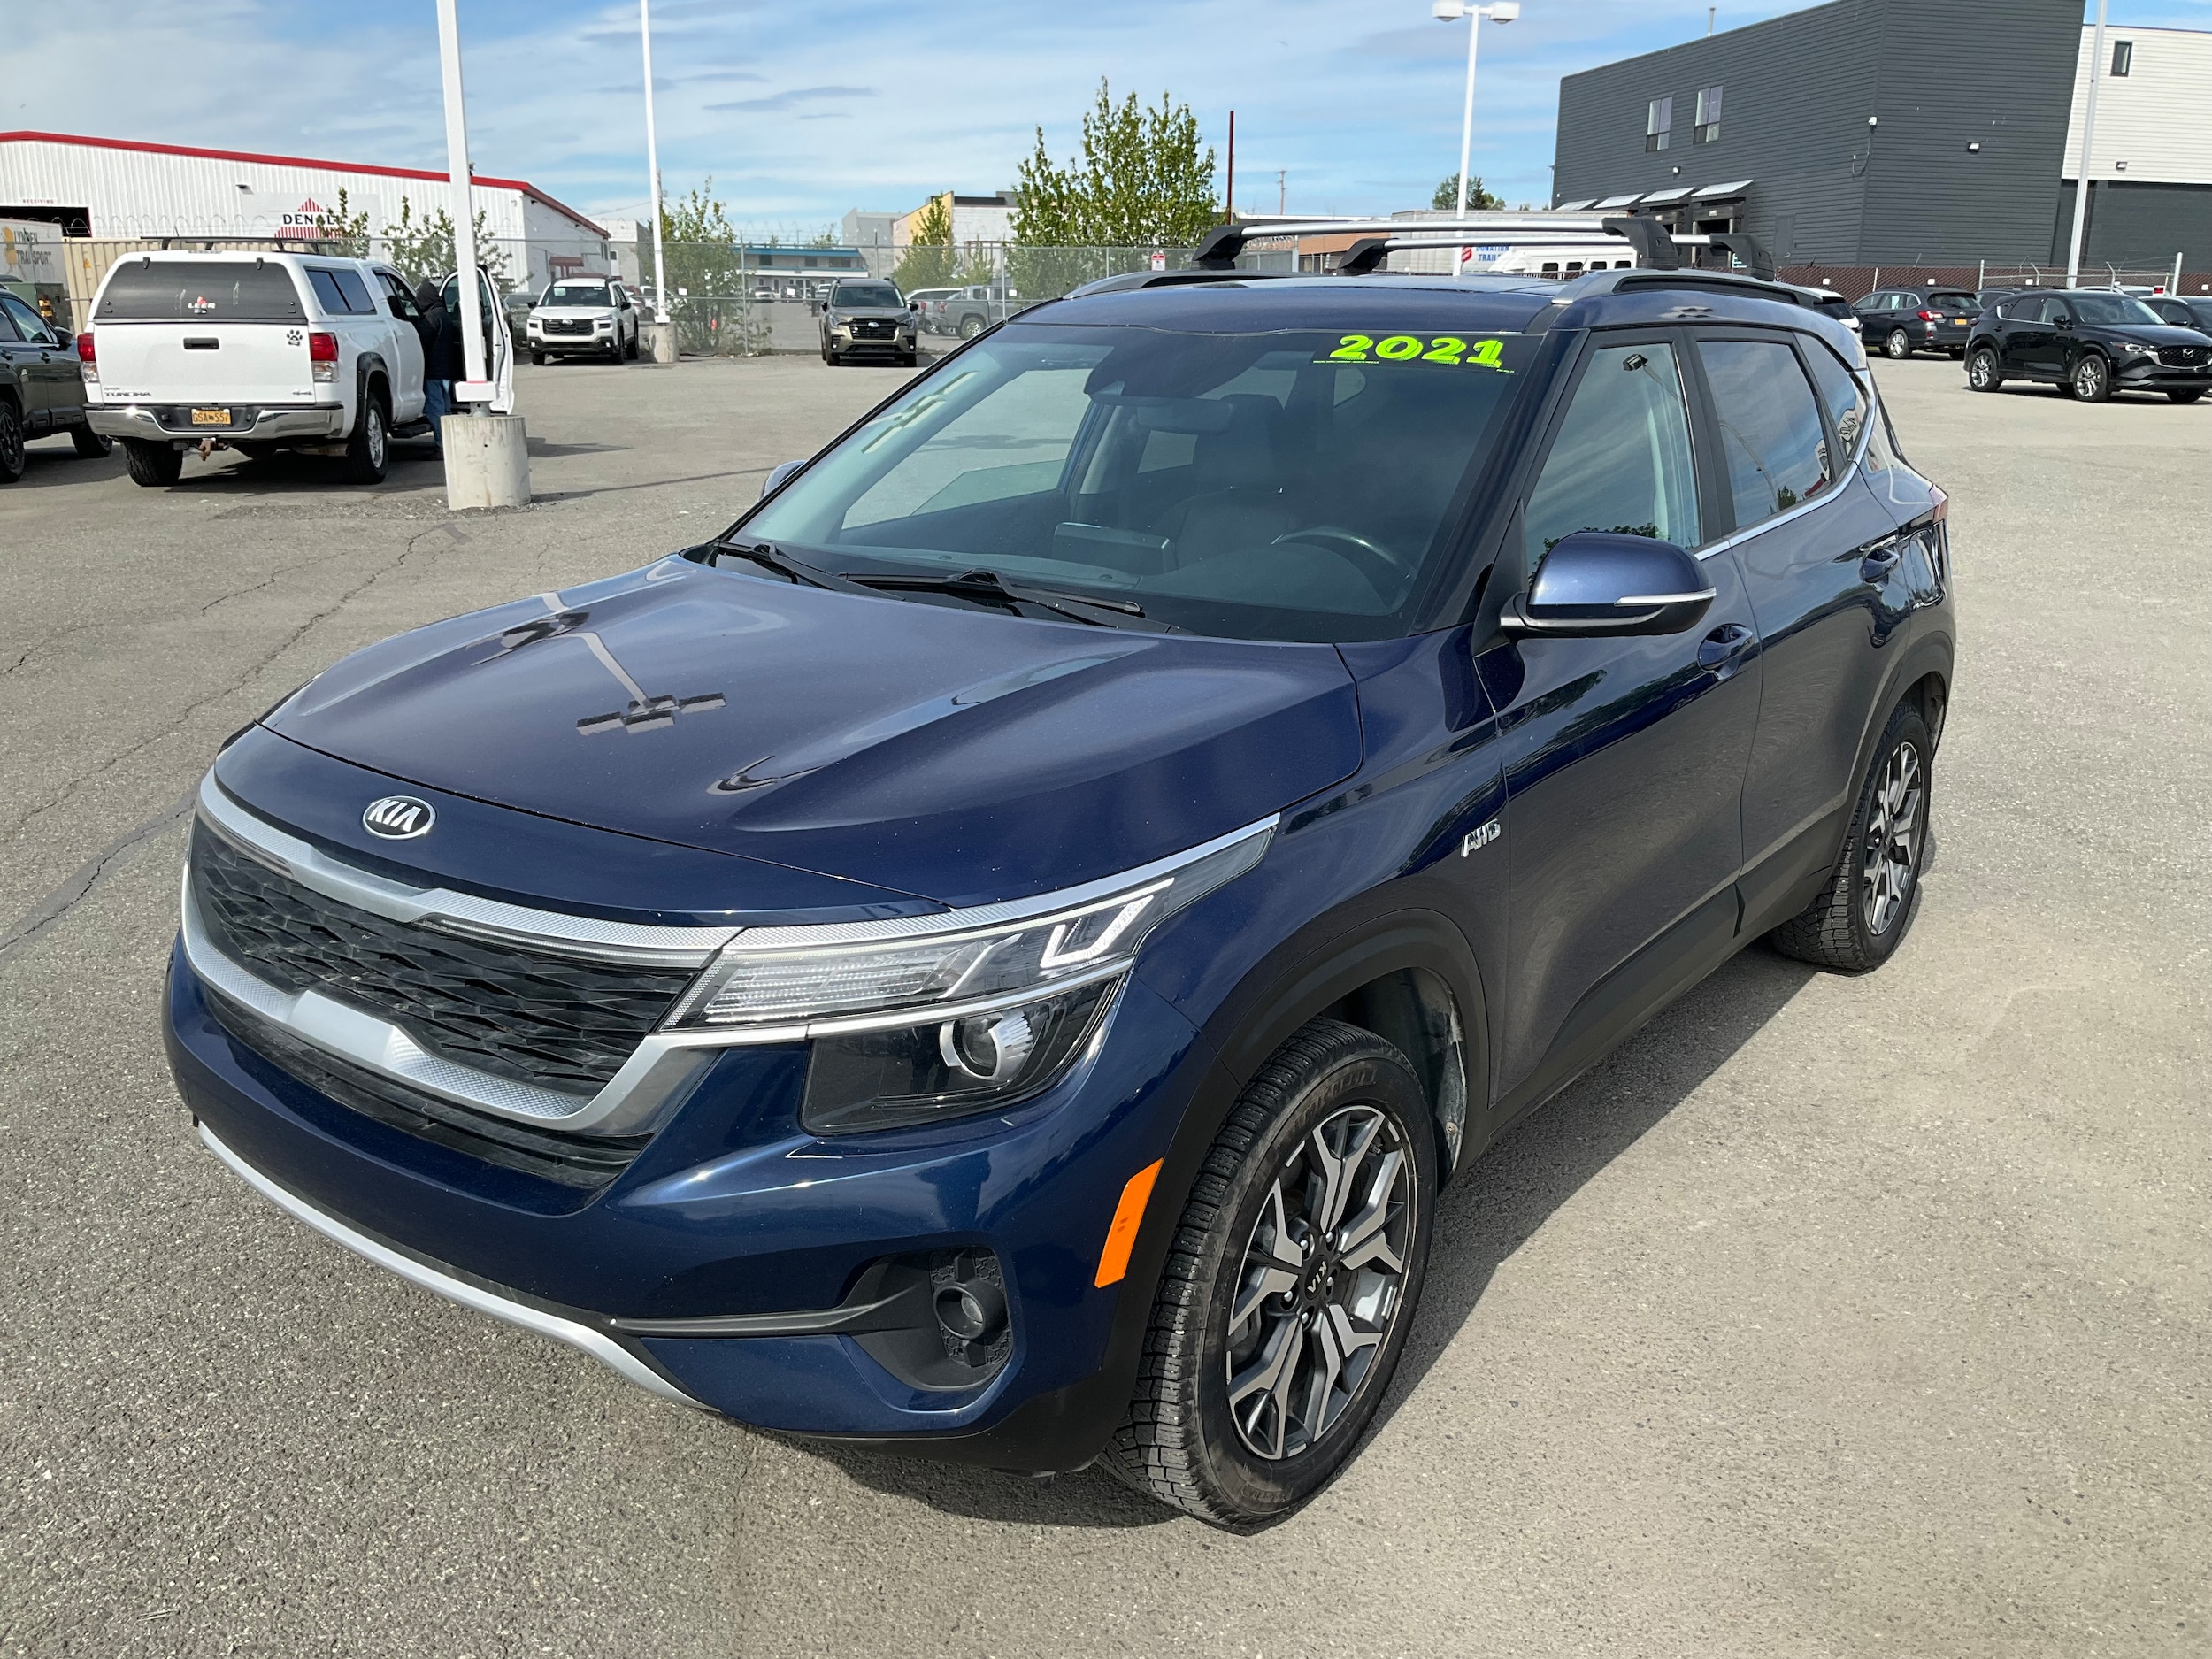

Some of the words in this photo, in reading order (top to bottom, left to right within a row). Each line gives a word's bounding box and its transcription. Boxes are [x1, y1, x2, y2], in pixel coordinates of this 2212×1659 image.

[282, 213, 342, 225] DENL
[1329, 334, 1504, 368] 2021
[367, 799, 422, 833] KIA
[1460, 818, 1502, 858] AWD
[1307, 1260, 1328, 1293] KIA
